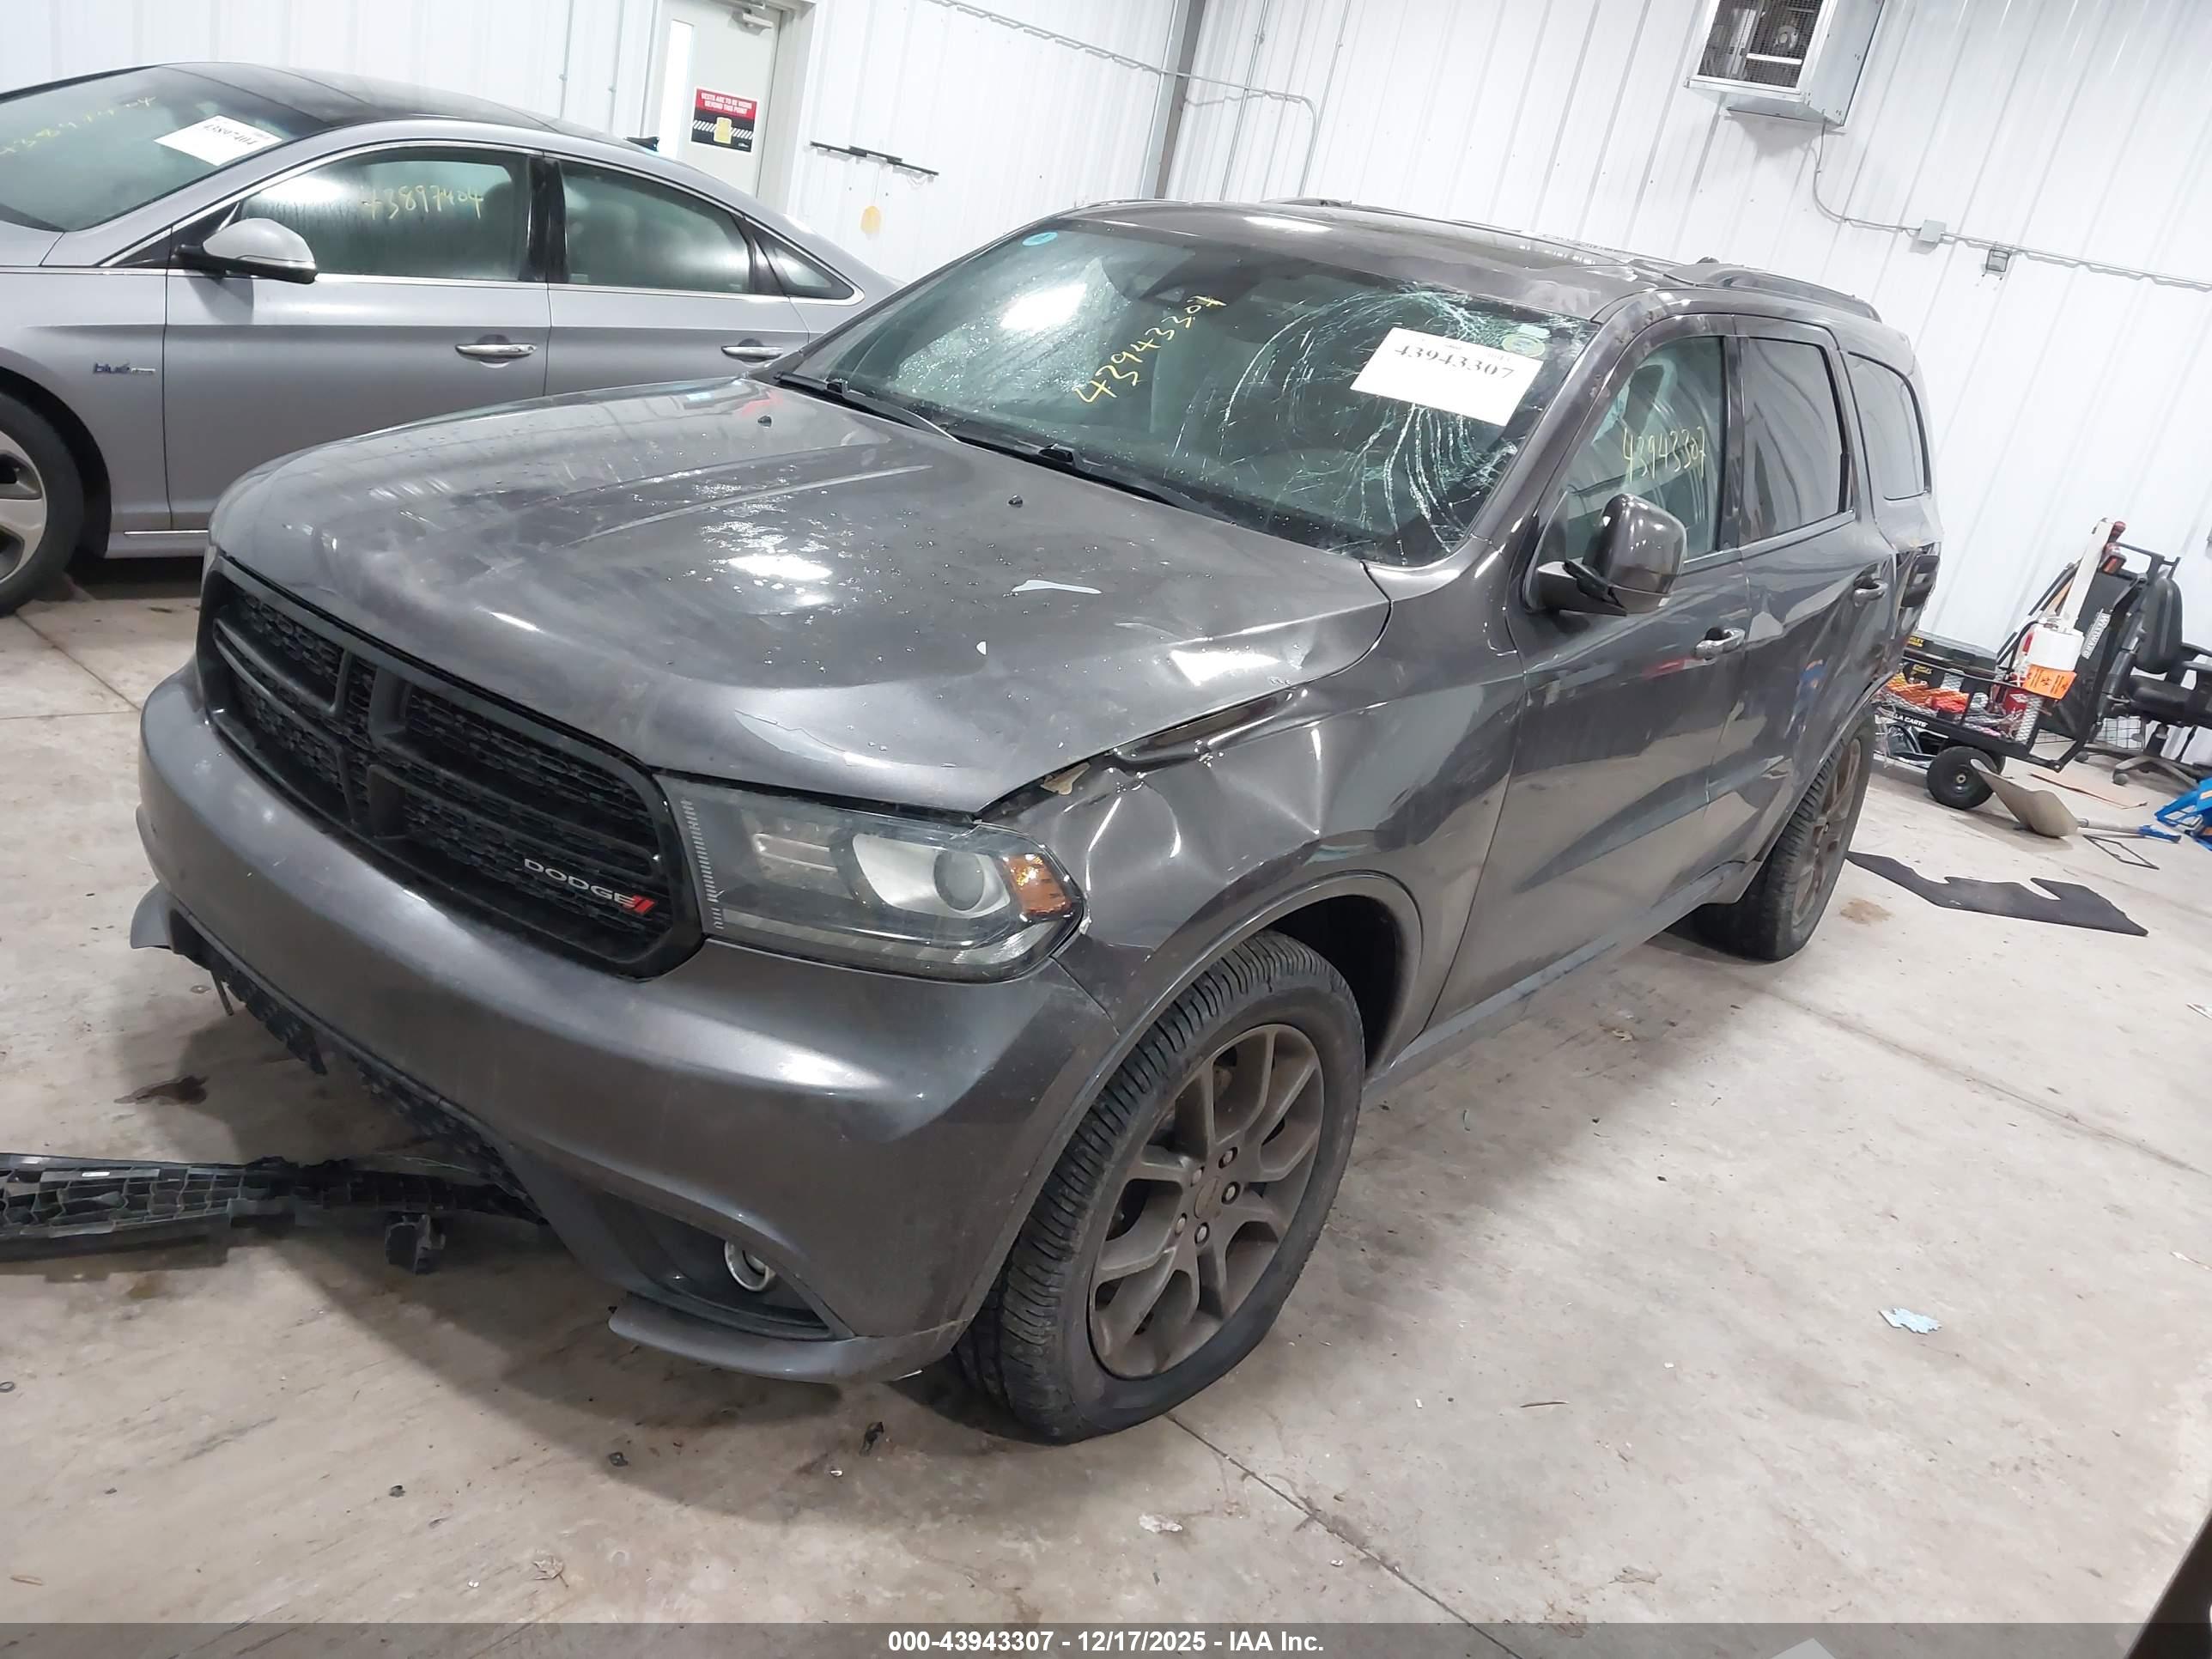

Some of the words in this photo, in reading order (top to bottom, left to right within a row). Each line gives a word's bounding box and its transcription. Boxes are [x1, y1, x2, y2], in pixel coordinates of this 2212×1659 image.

[1394, 344, 1515, 379] 43943307
[1622, 425, 1707, 483] 43943307
[524, 858, 638, 908] DODGE
